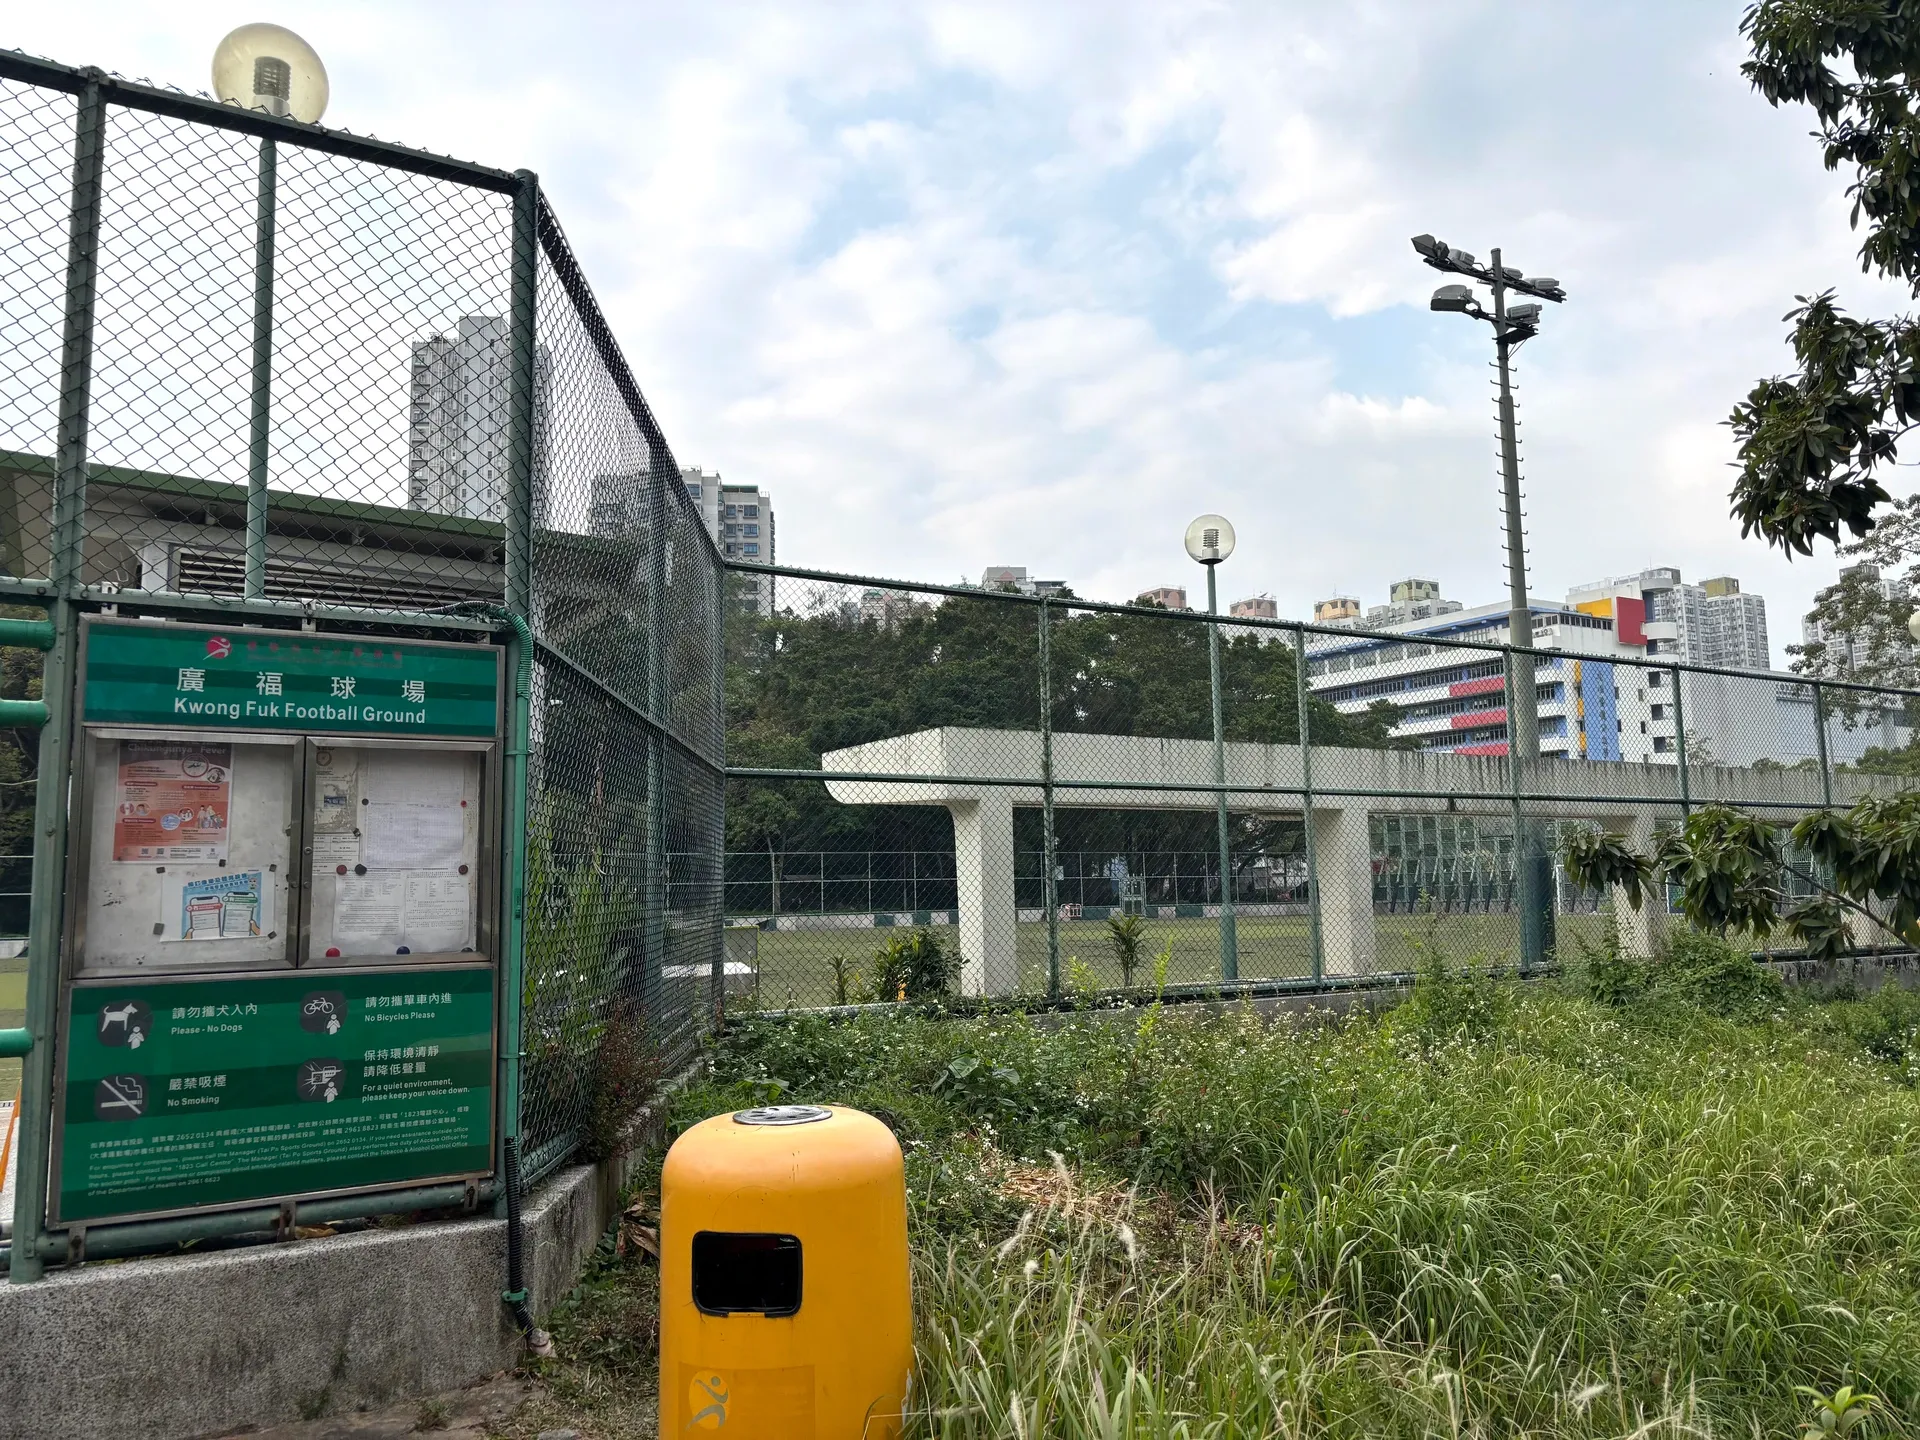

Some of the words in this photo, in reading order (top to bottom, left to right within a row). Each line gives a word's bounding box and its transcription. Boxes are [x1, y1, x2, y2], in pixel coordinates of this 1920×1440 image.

[177, 667, 425, 703] 廣福球場
[174, 697, 240, 719] Kwong
[246, 700, 280, 717] Fuk
[285, 702, 358, 720] Football
[362, 706, 426, 724] Ground
[128, 744, 192, 754] Chikungunya
[200, 746, 226, 754] Fever
[366, 992, 452, 1008] 請勿攜單車內進
[172, 1003, 258, 1020] 請勿攜犬入內
[376, 1012, 409, 1022] Bicycles
[171, 1026, 200, 1035] Please
[220, 1024, 242, 1032] Dogs
[364, 1045, 438, 1061] 保持環境清靜
[364, 1062, 426, 1078] 請降低聲量
[169, 1074, 226, 1090] 嚴禁吸煙
[383, 1082, 403, 1090] quiet
[404, 1078, 453, 1088] environment,
[168, 1099, 180, 1107] No
[182, 1096, 220, 1106] Smoking
[362, 1094, 387, 1103] please
[389, 1092, 407, 1100] keep
[408, 1090, 425, 1099] your
[448, 1086, 470, 1094] down.
